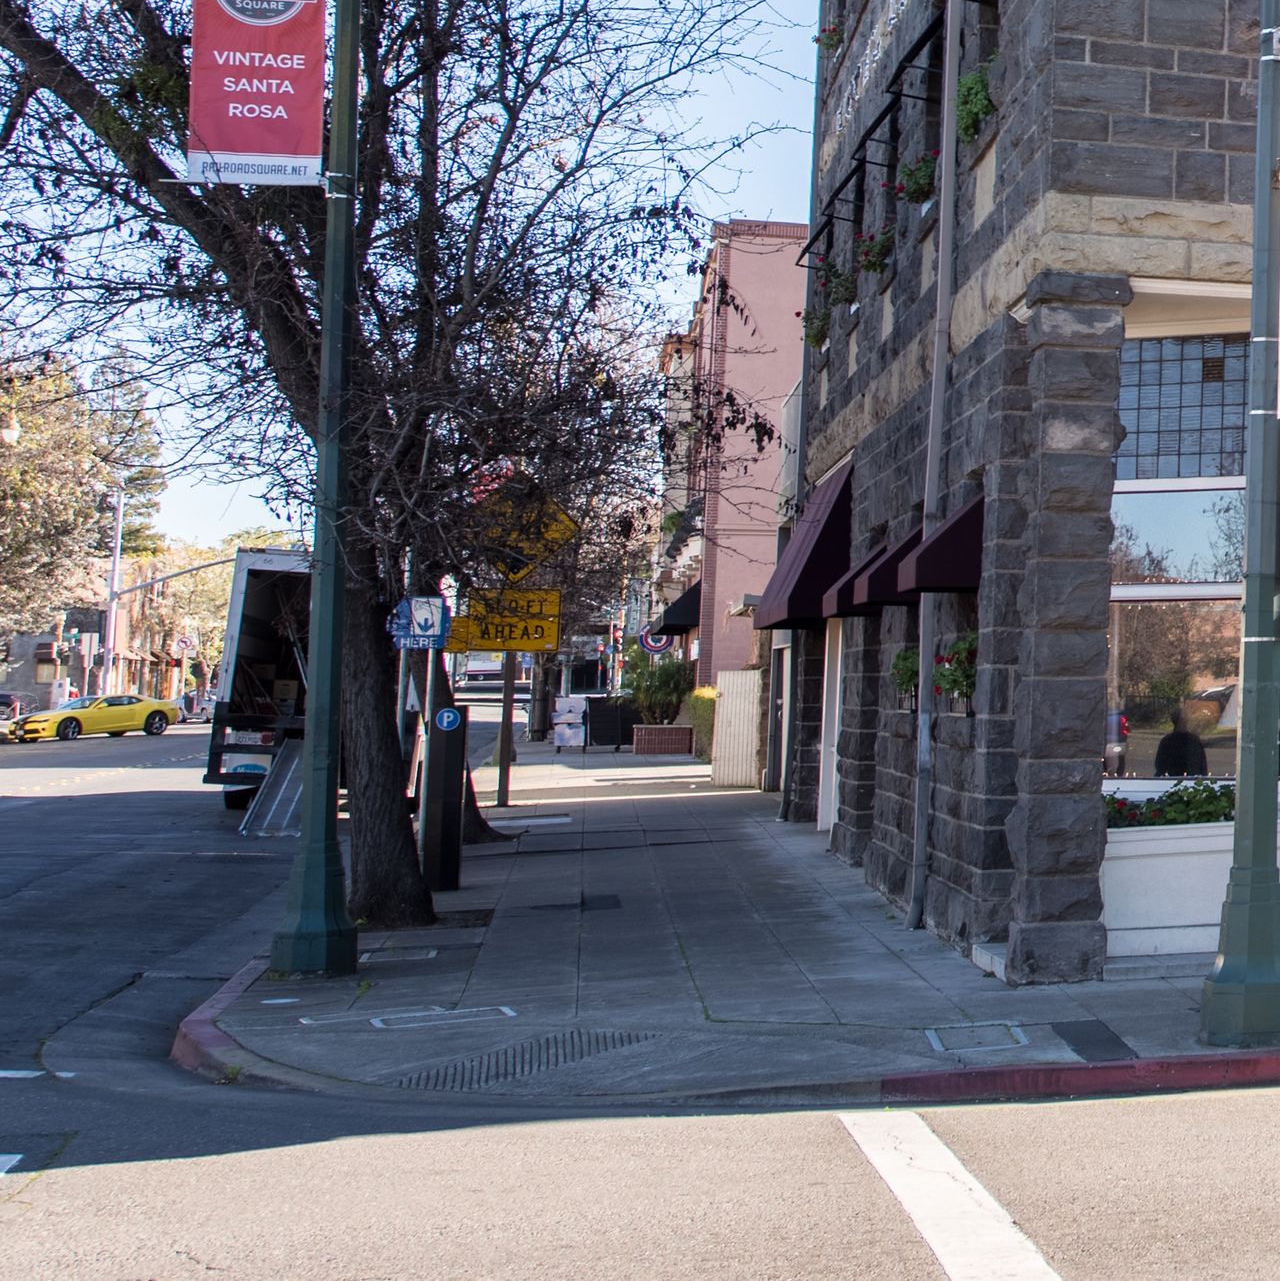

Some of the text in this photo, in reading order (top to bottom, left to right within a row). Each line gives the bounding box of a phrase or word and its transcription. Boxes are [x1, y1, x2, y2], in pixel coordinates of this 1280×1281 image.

[235, 0, 285, 10] SQUARE
[213, 50, 305, 69] VINTAGE
[223, 77, 294, 94] SANTA
[228, 103, 287, 118] ROSA
[481, 622, 545, 640] AHEAD
[400, 637, 438, 648] HERE
[443, 712, 454, 727] P
